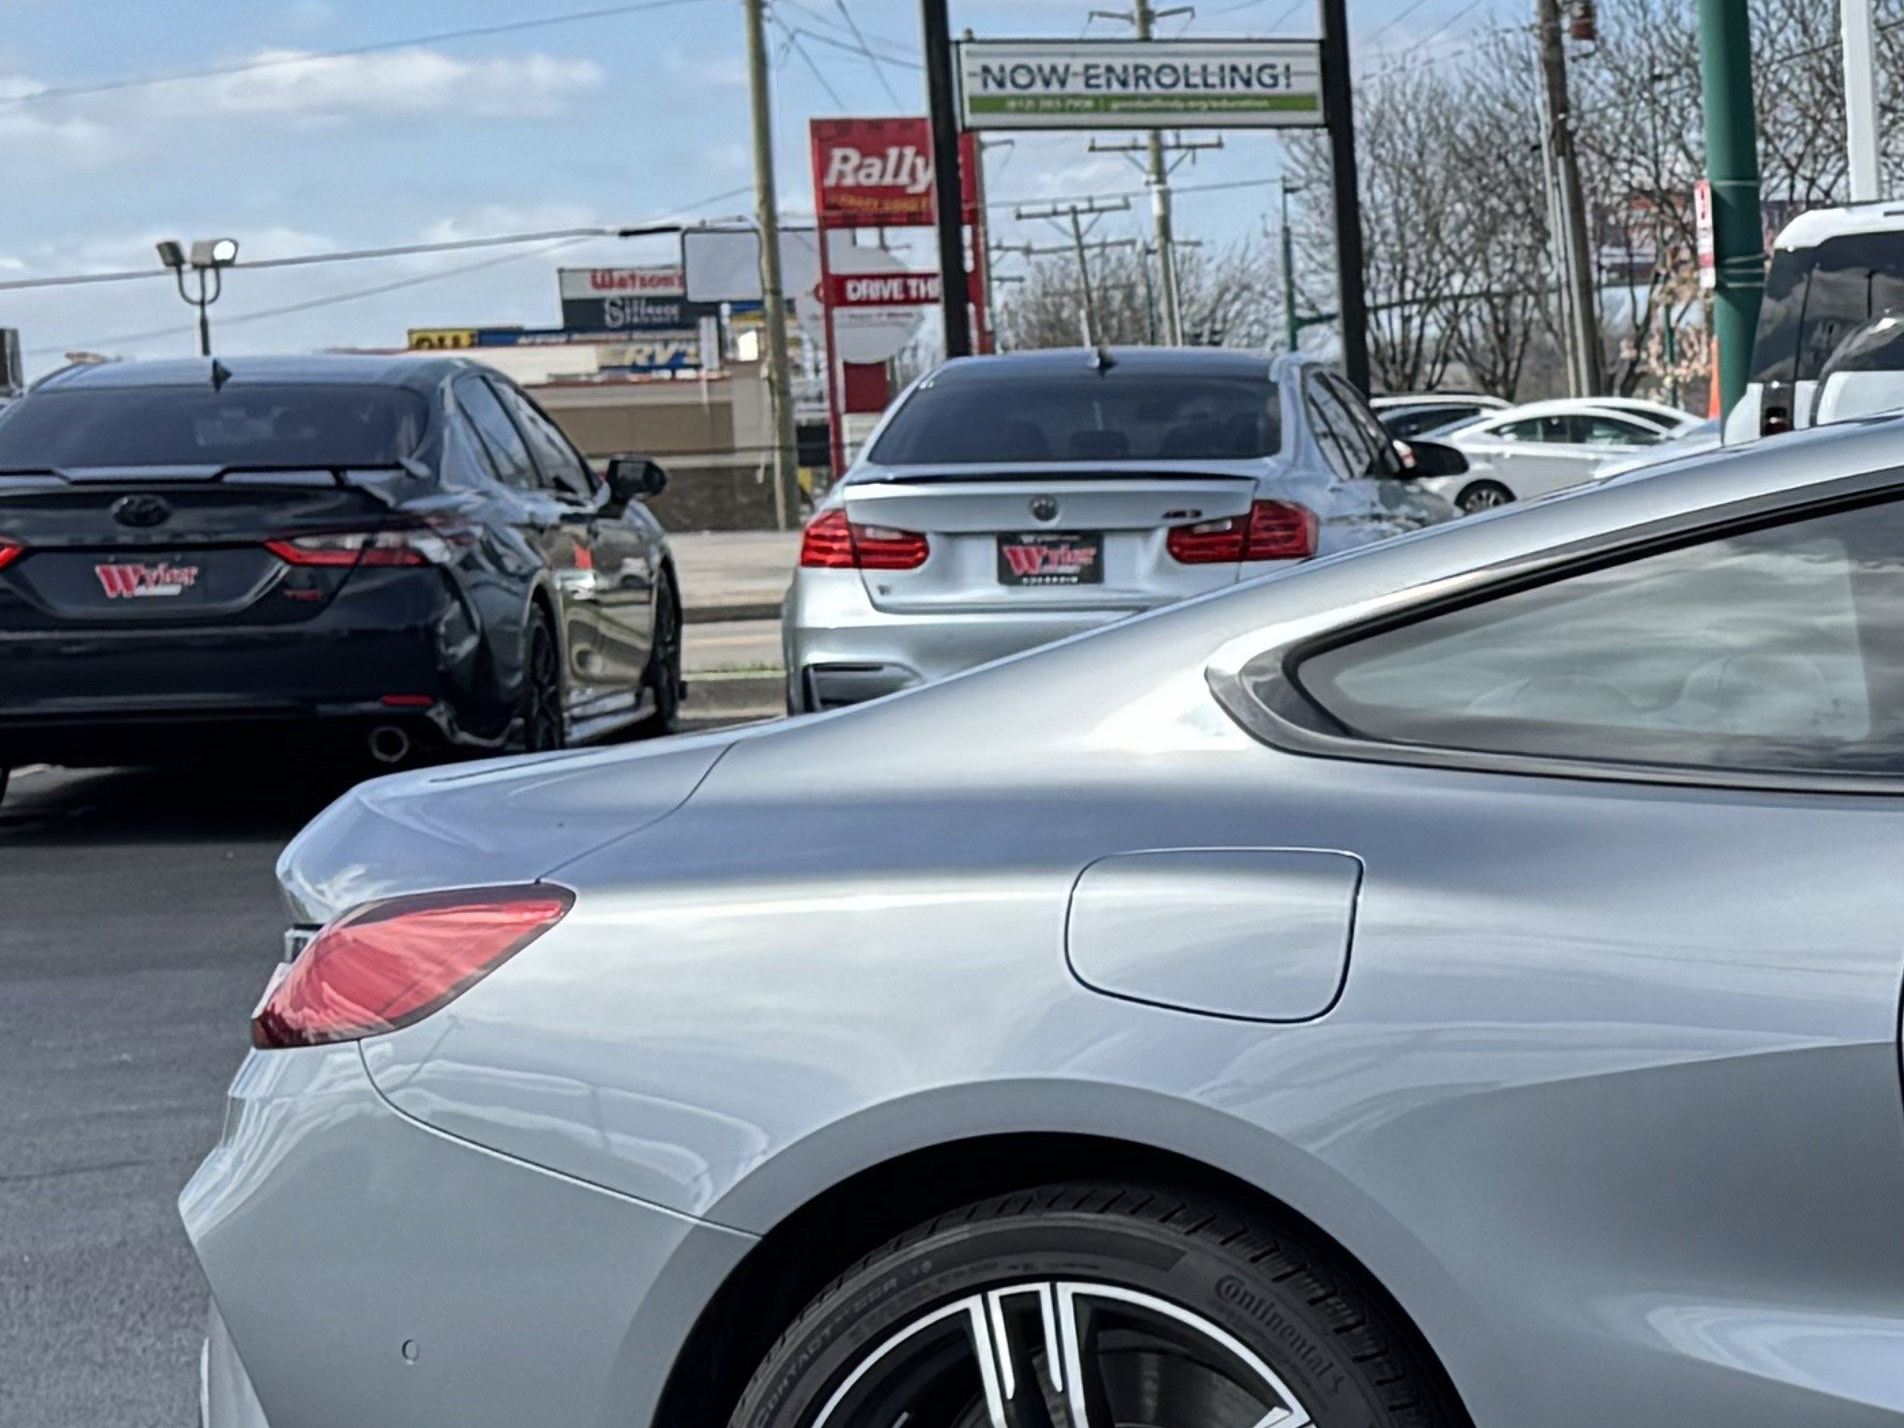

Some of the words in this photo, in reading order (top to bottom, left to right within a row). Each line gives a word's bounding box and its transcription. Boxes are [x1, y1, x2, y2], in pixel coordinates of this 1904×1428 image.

[982, 63, 1071, 90] NOW
[1084, 63, 1292, 90] ENROLLING!
[824, 146, 935, 194] Rally
[846, 278, 904, 301] DRIVE
[1214, 1274, 1335, 1380] Continental
